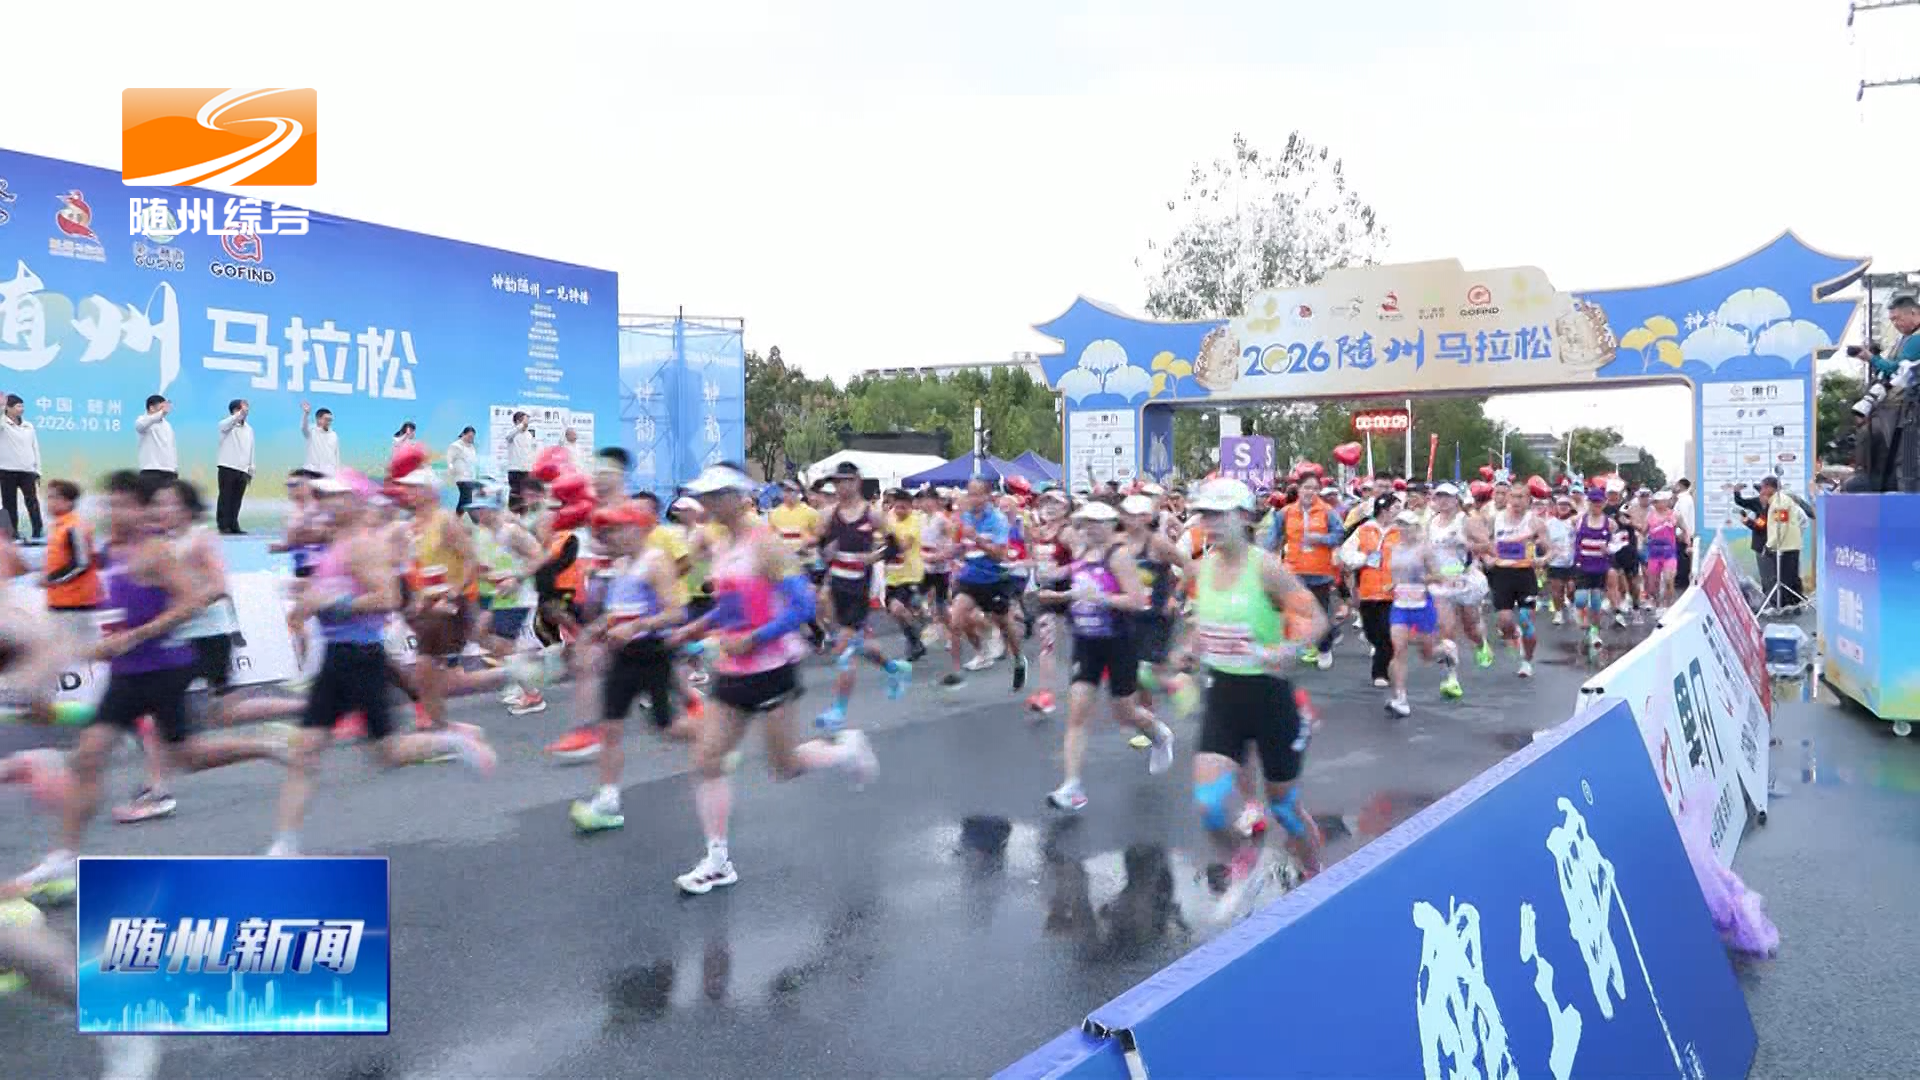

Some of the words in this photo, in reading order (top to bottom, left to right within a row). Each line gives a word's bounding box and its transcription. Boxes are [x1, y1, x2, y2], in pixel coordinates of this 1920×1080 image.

[210, 262, 275, 283] GOFIND
[36, 415, 121, 432] 2026.10.18
[1234, 443, 1251, 467] S
